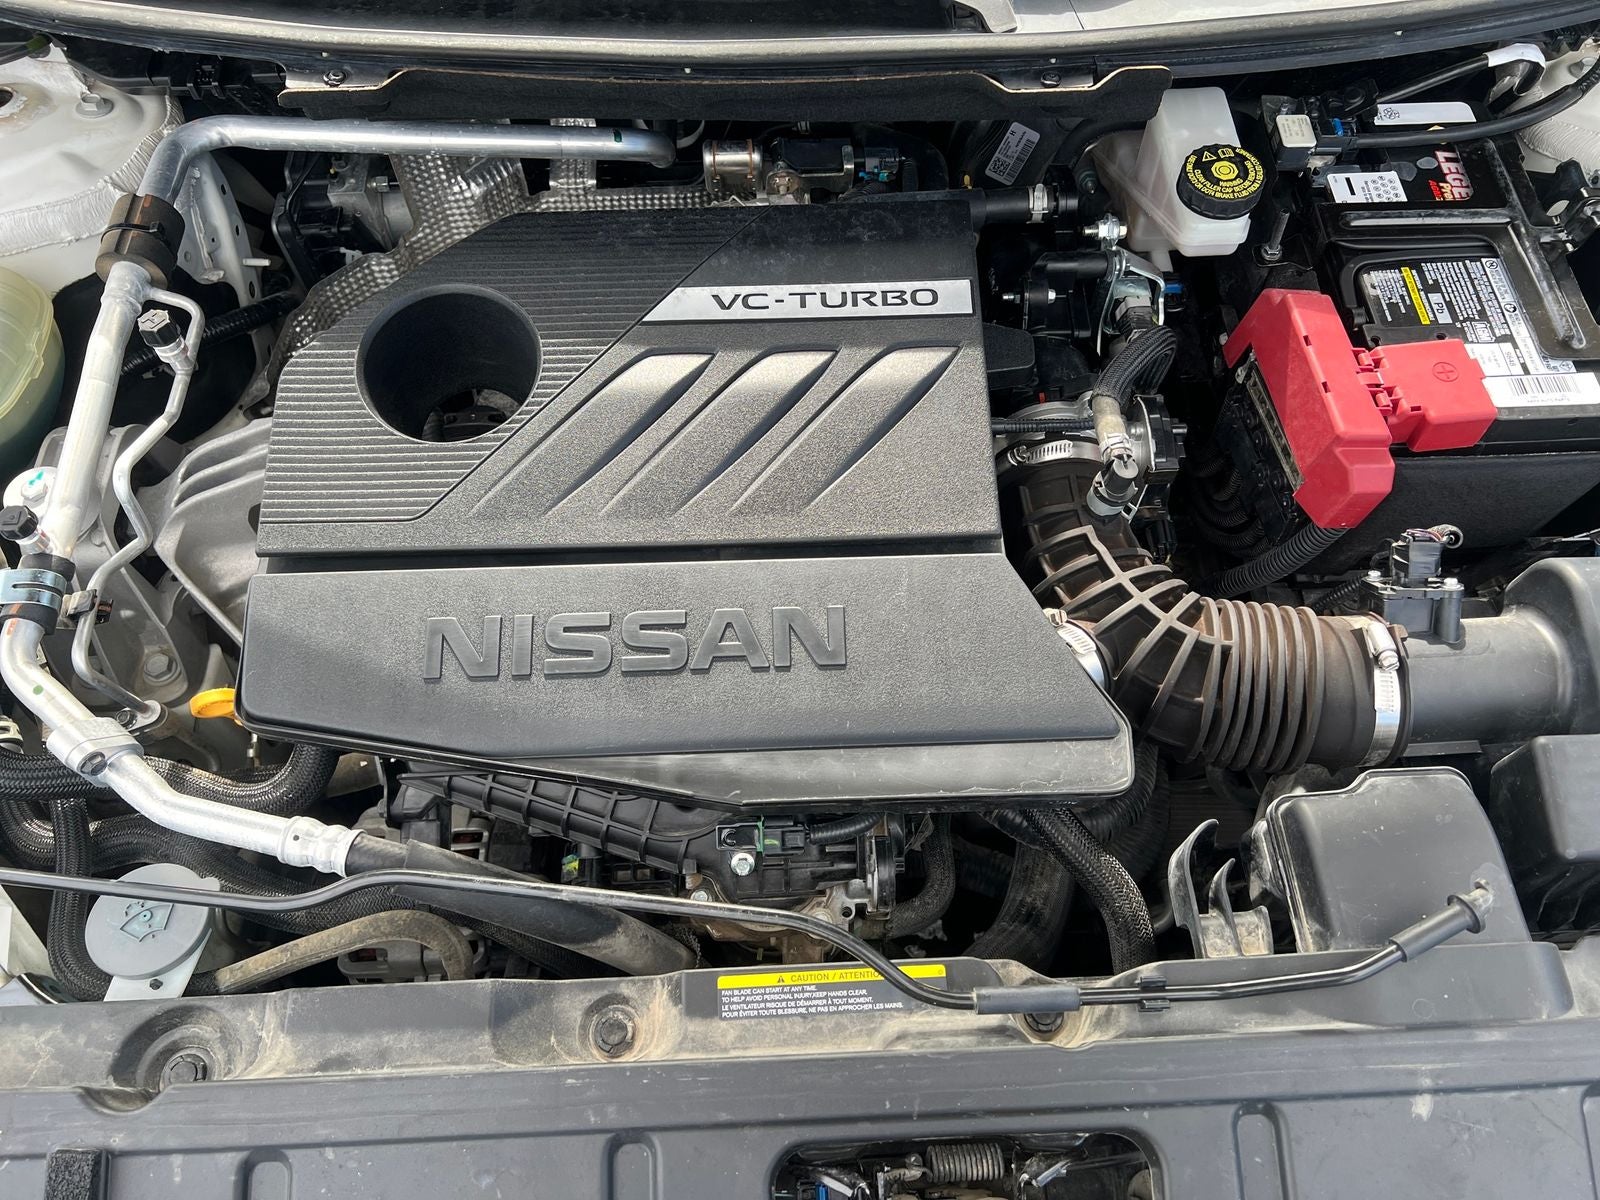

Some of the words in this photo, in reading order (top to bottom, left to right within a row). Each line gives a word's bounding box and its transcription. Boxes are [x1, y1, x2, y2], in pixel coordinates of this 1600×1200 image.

[1434, 151, 1473, 200] LEGE
[1204, 181, 1221, 192] FILLER
[1438, 182, 1454, 200] Pre
[711, 288, 939, 311] VC-TURBO
[1434, 302, 1444, 314] Pb
[423, 604, 847, 681] NISSAN
[790, 972, 830, 982] CAUTION
[840, 970, 880, 980] ATTENTIO
[796, 998, 827, 1006] DÉMARRER
